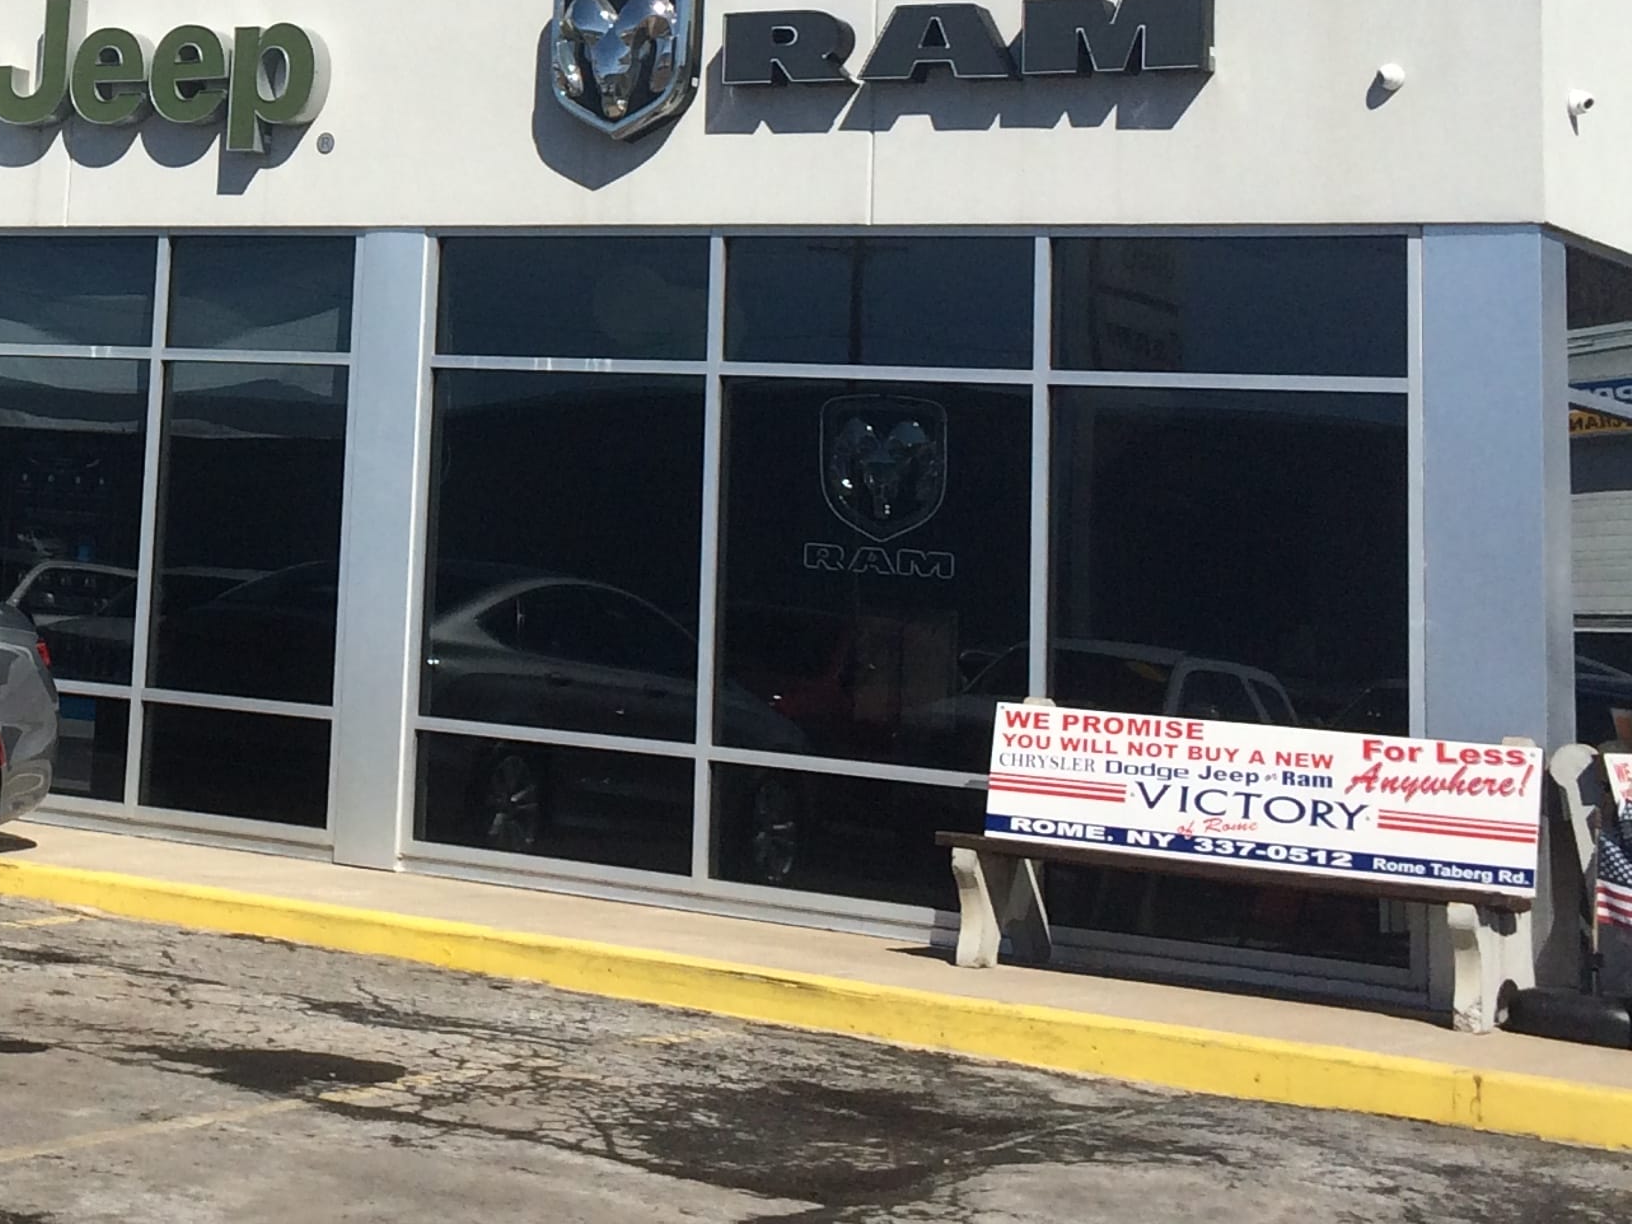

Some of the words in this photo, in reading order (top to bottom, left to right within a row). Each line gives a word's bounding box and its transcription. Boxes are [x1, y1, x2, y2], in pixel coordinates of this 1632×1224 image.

[804, 542, 955, 579] RAM
[1005, 710, 1050, 729] WE
[1062, 715, 1204, 740] PROMISE
[1002, 733, 1050, 750] YOU
[1060, 737, 1118, 755] WILL
[1127, 741, 1178, 759] NOT
[1188, 746, 1239, 763] BUY
[1249, 750, 1265, 765] A
[1275, 751, 1333, 769] NEW
[1362, 739, 1423, 762] For
[1436, 742, 1526, 766] Less
[999, 752, 1095, 773] CHRYSLER
[1105, 760, 1189, 781] Dodge
[1198, 765, 1259, 786] Jeep
[1282, 771, 1333, 788] Ram
[1344, 762, 1534, 803] Anywhere!
[1136, 781, 1369, 831] VICTORY
[1176, 820, 1193, 839] of
[1203, 817, 1258, 834] Rome
[1127, 829, 1175, 848] NY
[1193, 837, 1352, 867] 337-0512
[1372, 858, 1426, 875] Rome
[1430, 863, 1493, 883] Taberg
[1498, 869, 1530, 885] Rd.
